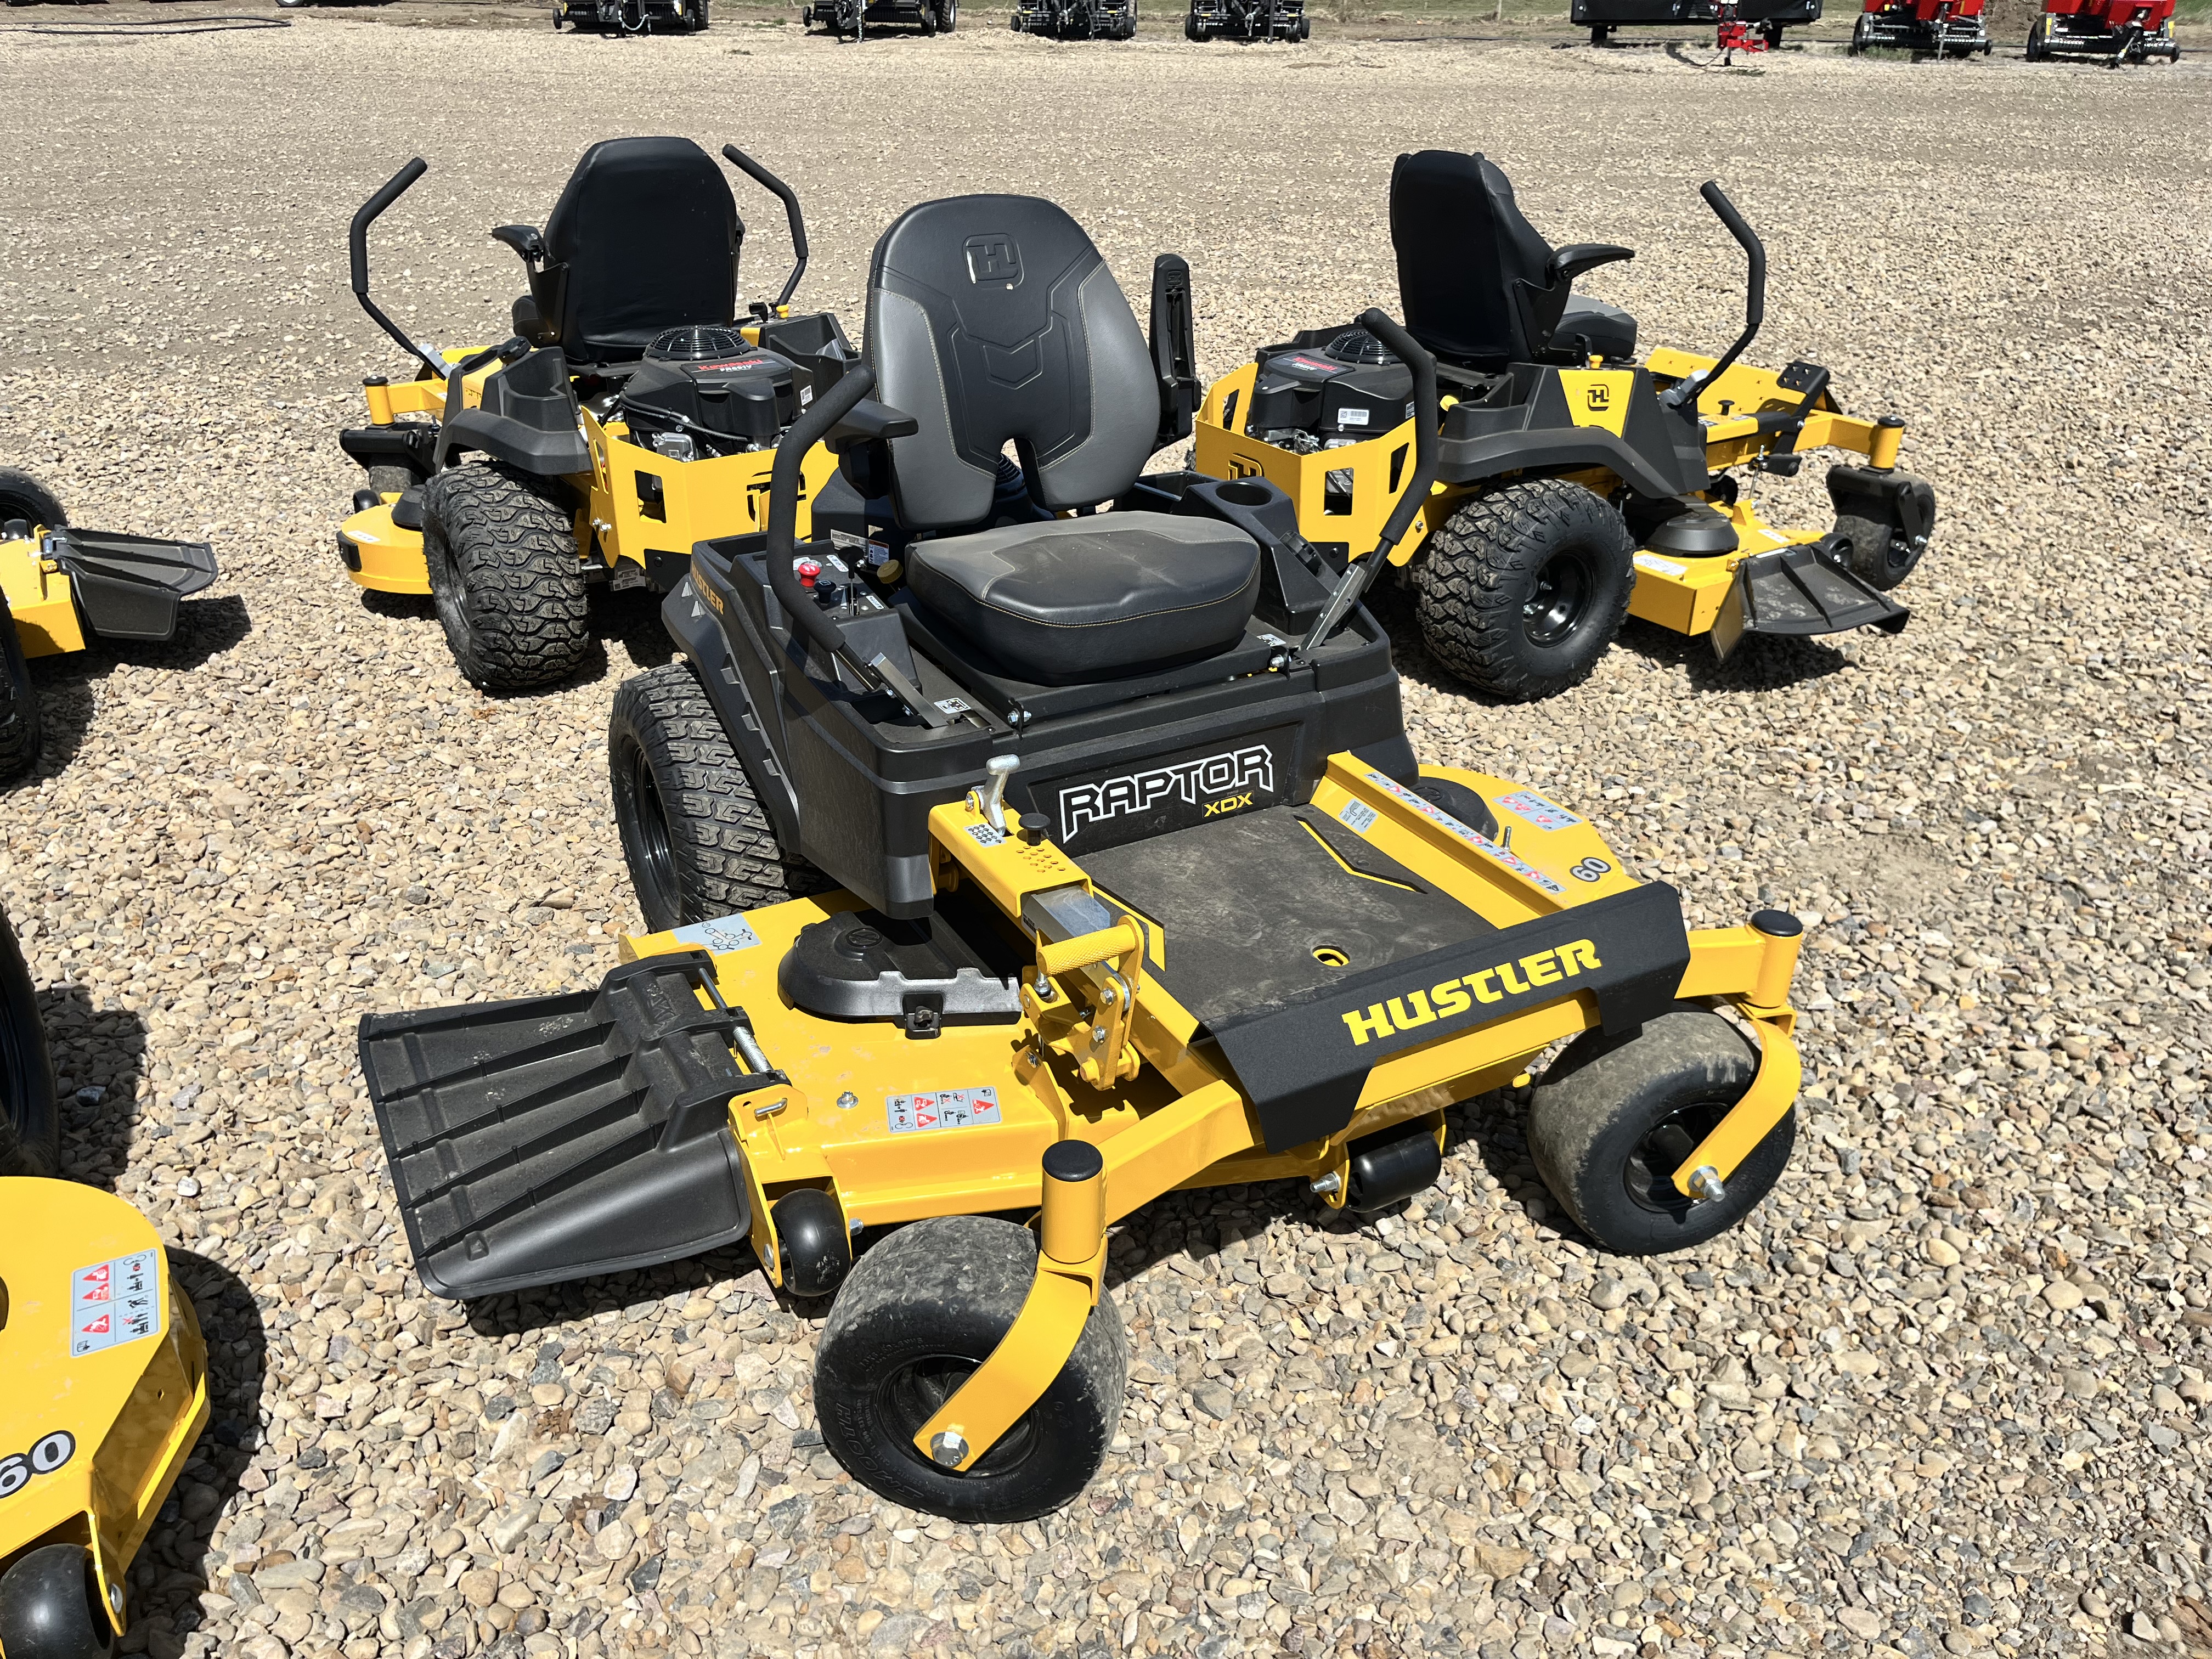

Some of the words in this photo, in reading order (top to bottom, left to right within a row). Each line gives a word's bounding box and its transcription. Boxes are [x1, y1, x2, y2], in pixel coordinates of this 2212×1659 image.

[691, 561, 724, 615] HUSTLER
[1059, 744, 1274, 844] RAPTOR
[1204, 792, 1254, 817] XDX
[1570, 857, 1611, 882] 60
[1341, 939, 1602, 1046] HUSTLER
[0, 1430, 76, 1499] 60
[837, 1403, 924, 1499] SMOOTH
